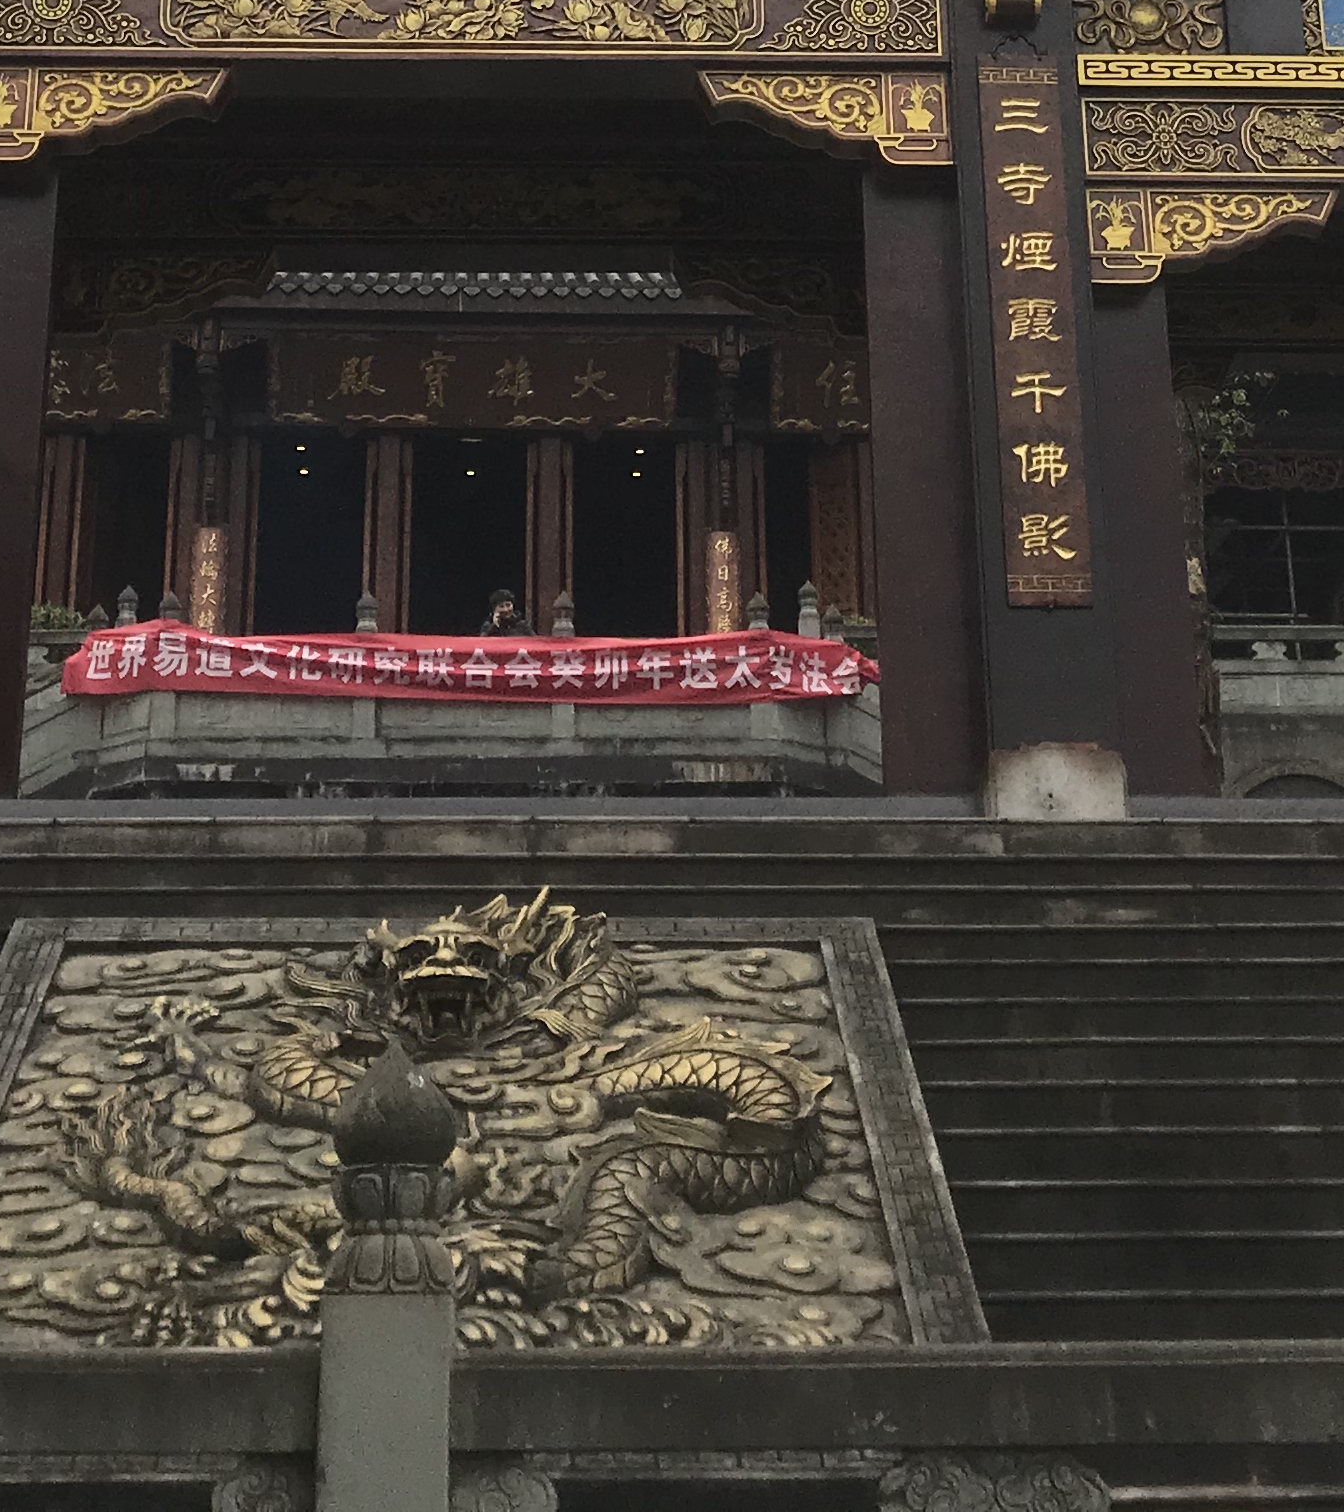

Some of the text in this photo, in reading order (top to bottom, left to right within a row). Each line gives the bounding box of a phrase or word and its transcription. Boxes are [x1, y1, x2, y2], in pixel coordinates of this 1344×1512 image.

[993, 96, 1077, 561] 三寺煙霞千佛影
[85, 630, 864, 695] 世界易道文化研究联合会癸卯年送太岁法会
